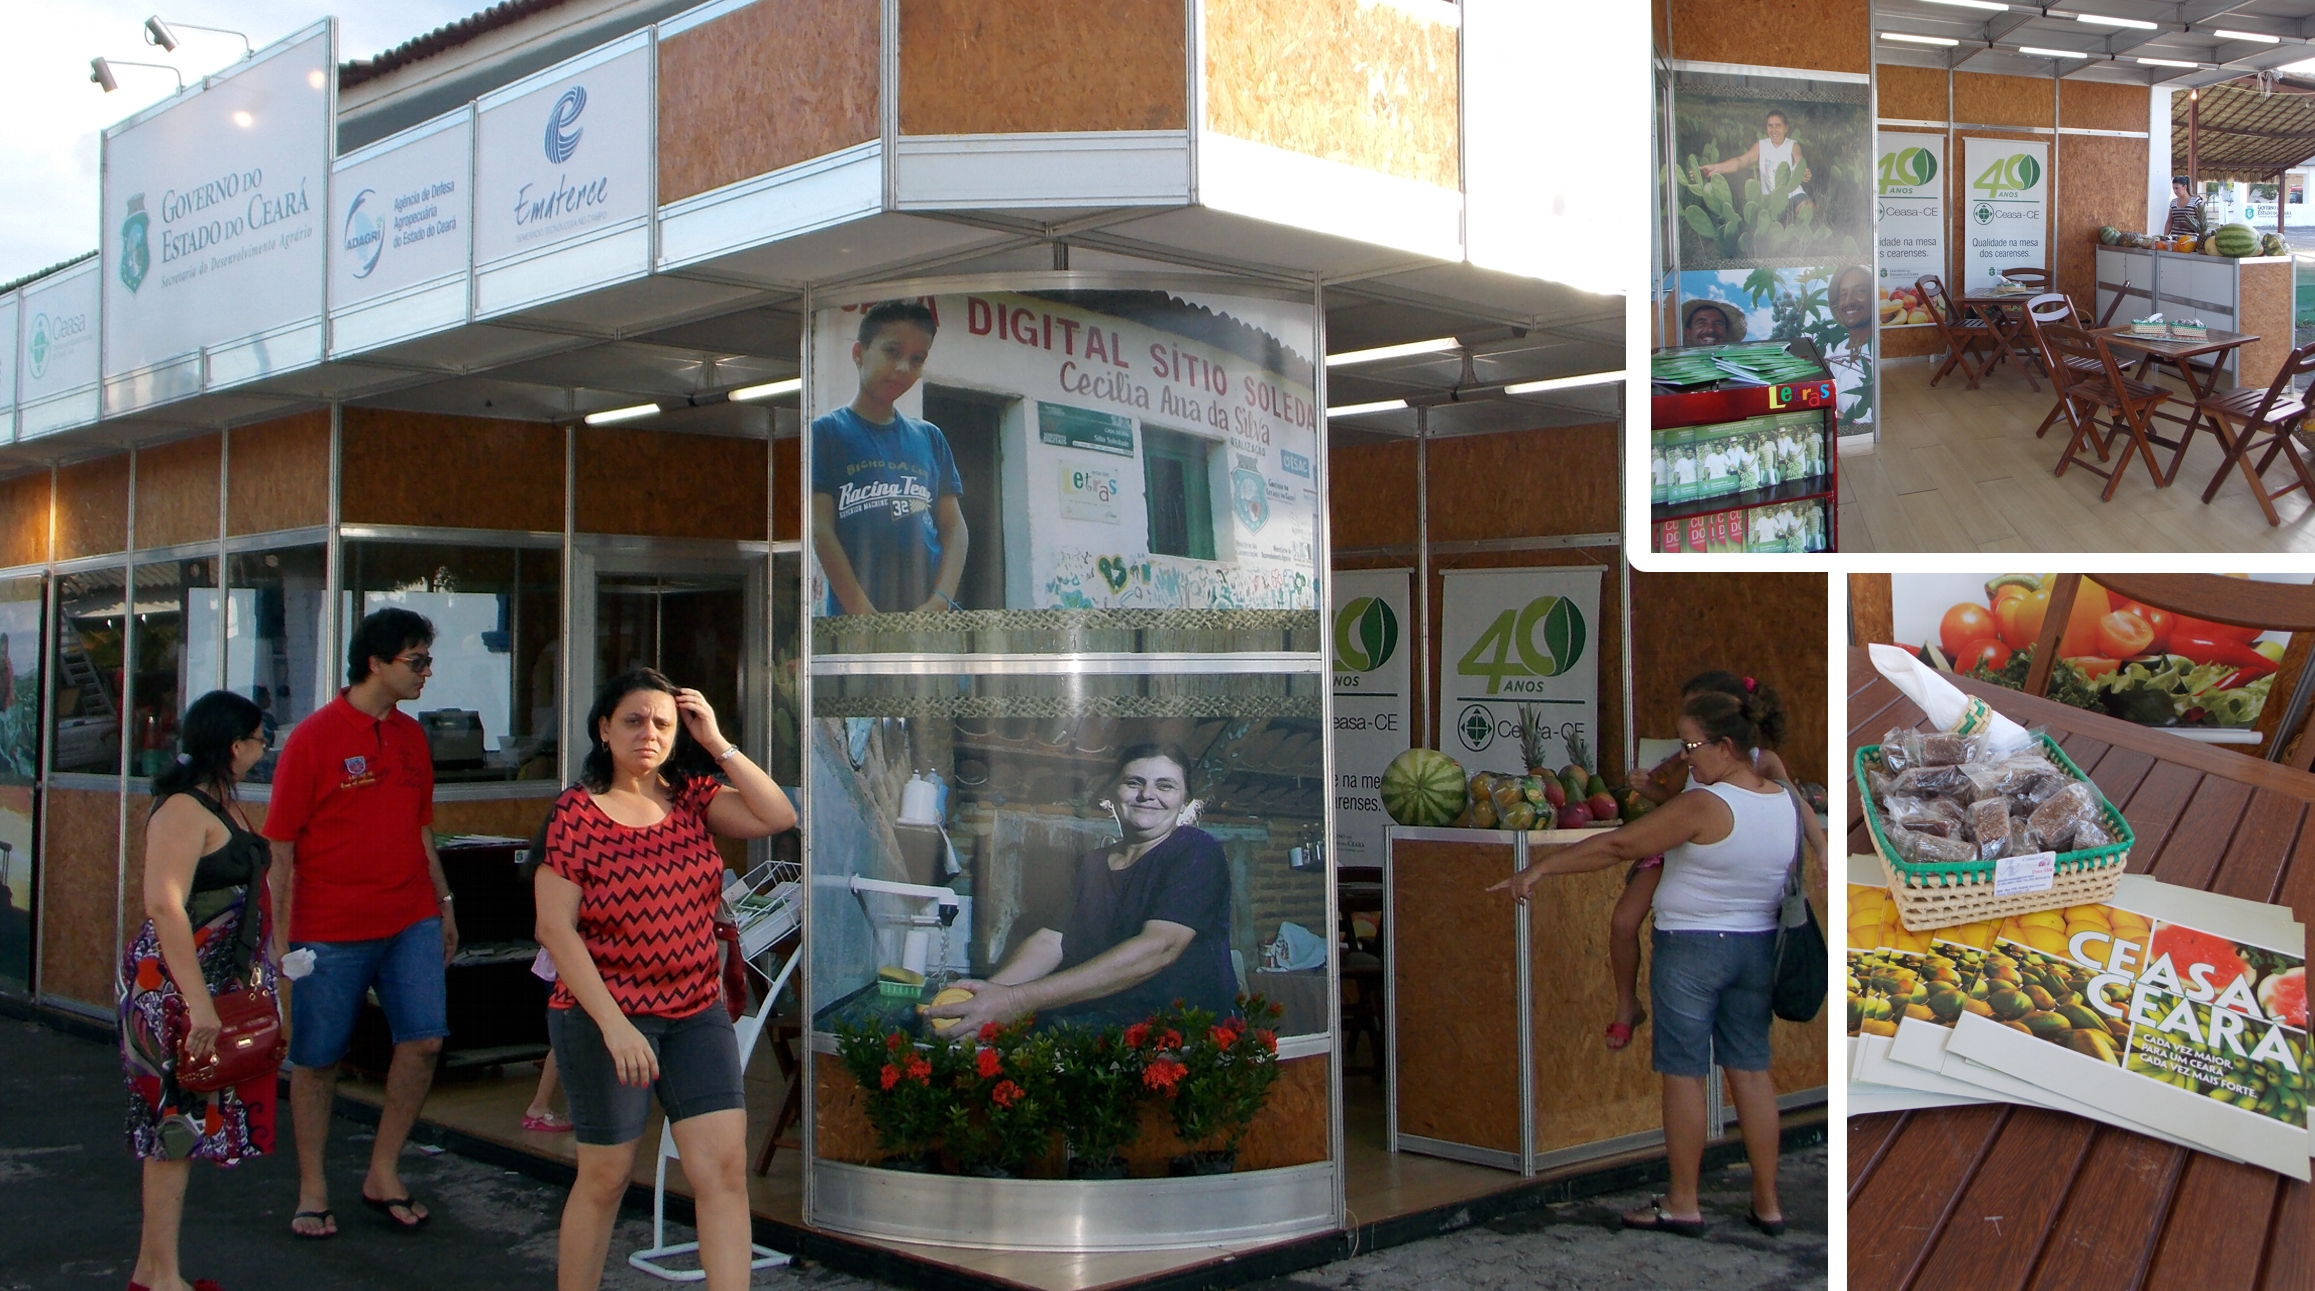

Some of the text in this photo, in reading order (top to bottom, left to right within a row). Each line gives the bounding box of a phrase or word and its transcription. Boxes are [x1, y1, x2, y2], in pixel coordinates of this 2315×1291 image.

[393, 180, 455, 213] Agência de Defesa
[515, 173, 608, 226] Ematerce
[393, 204, 438, 232] Agropecuária
[1886, 207, 1938, 217] Ceasa-CE
[1995, 210, 2040, 220] Ceasa-CE
[346, 229, 381, 251] ADAGRI
[392, 215, 457, 249] do Estado do Ceará
[1879, 237, 1937, 247] idade na mesa
[1972, 238, 2039, 248] Qualidade na mesa
[161, 265, 197, 289] Secretaria
[211, 239, 276, 272] Desenvolvimento
[279, 224, 313, 251] Agrário
[1979, 249, 1994, 258] dos
[53, 313, 86, 340] Ceasa
[968, 296, 1130, 369] DIGITAL
[1769, 383, 1830, 409] Letras
[1208, 400, 1229, 432] da
[1234, 406, 1271, 447] Silva
[846, 460, 885, 476] BICHO
[888, 461, 908, 471] DA
[839, 480, 902, 511] Racing
[1062, 466, 1118, 502] Letras
[892, 500, 909, 517] 32
[1333, 675, 1360, 687] NOS
[1503, 680, 1545, 693] ANOS
[1333, 713, 1399, 732] easa-CE
[1343, 773, 1358, 789] na
[2068, 930, 2265, 1020] CEASA
[2086, 972, 2301, 1075] CEARÁ
[2141, 1044, 2169, 1060] PARA
[2169, 1052, 2188, 1066] UM
[2143, 1033, 2172, 1051] CADA
[2173, 1042, 2193, 1057] VEZ
[2139, 1053, 2258, 1099] CADA VEZ MAIS FORTE.
